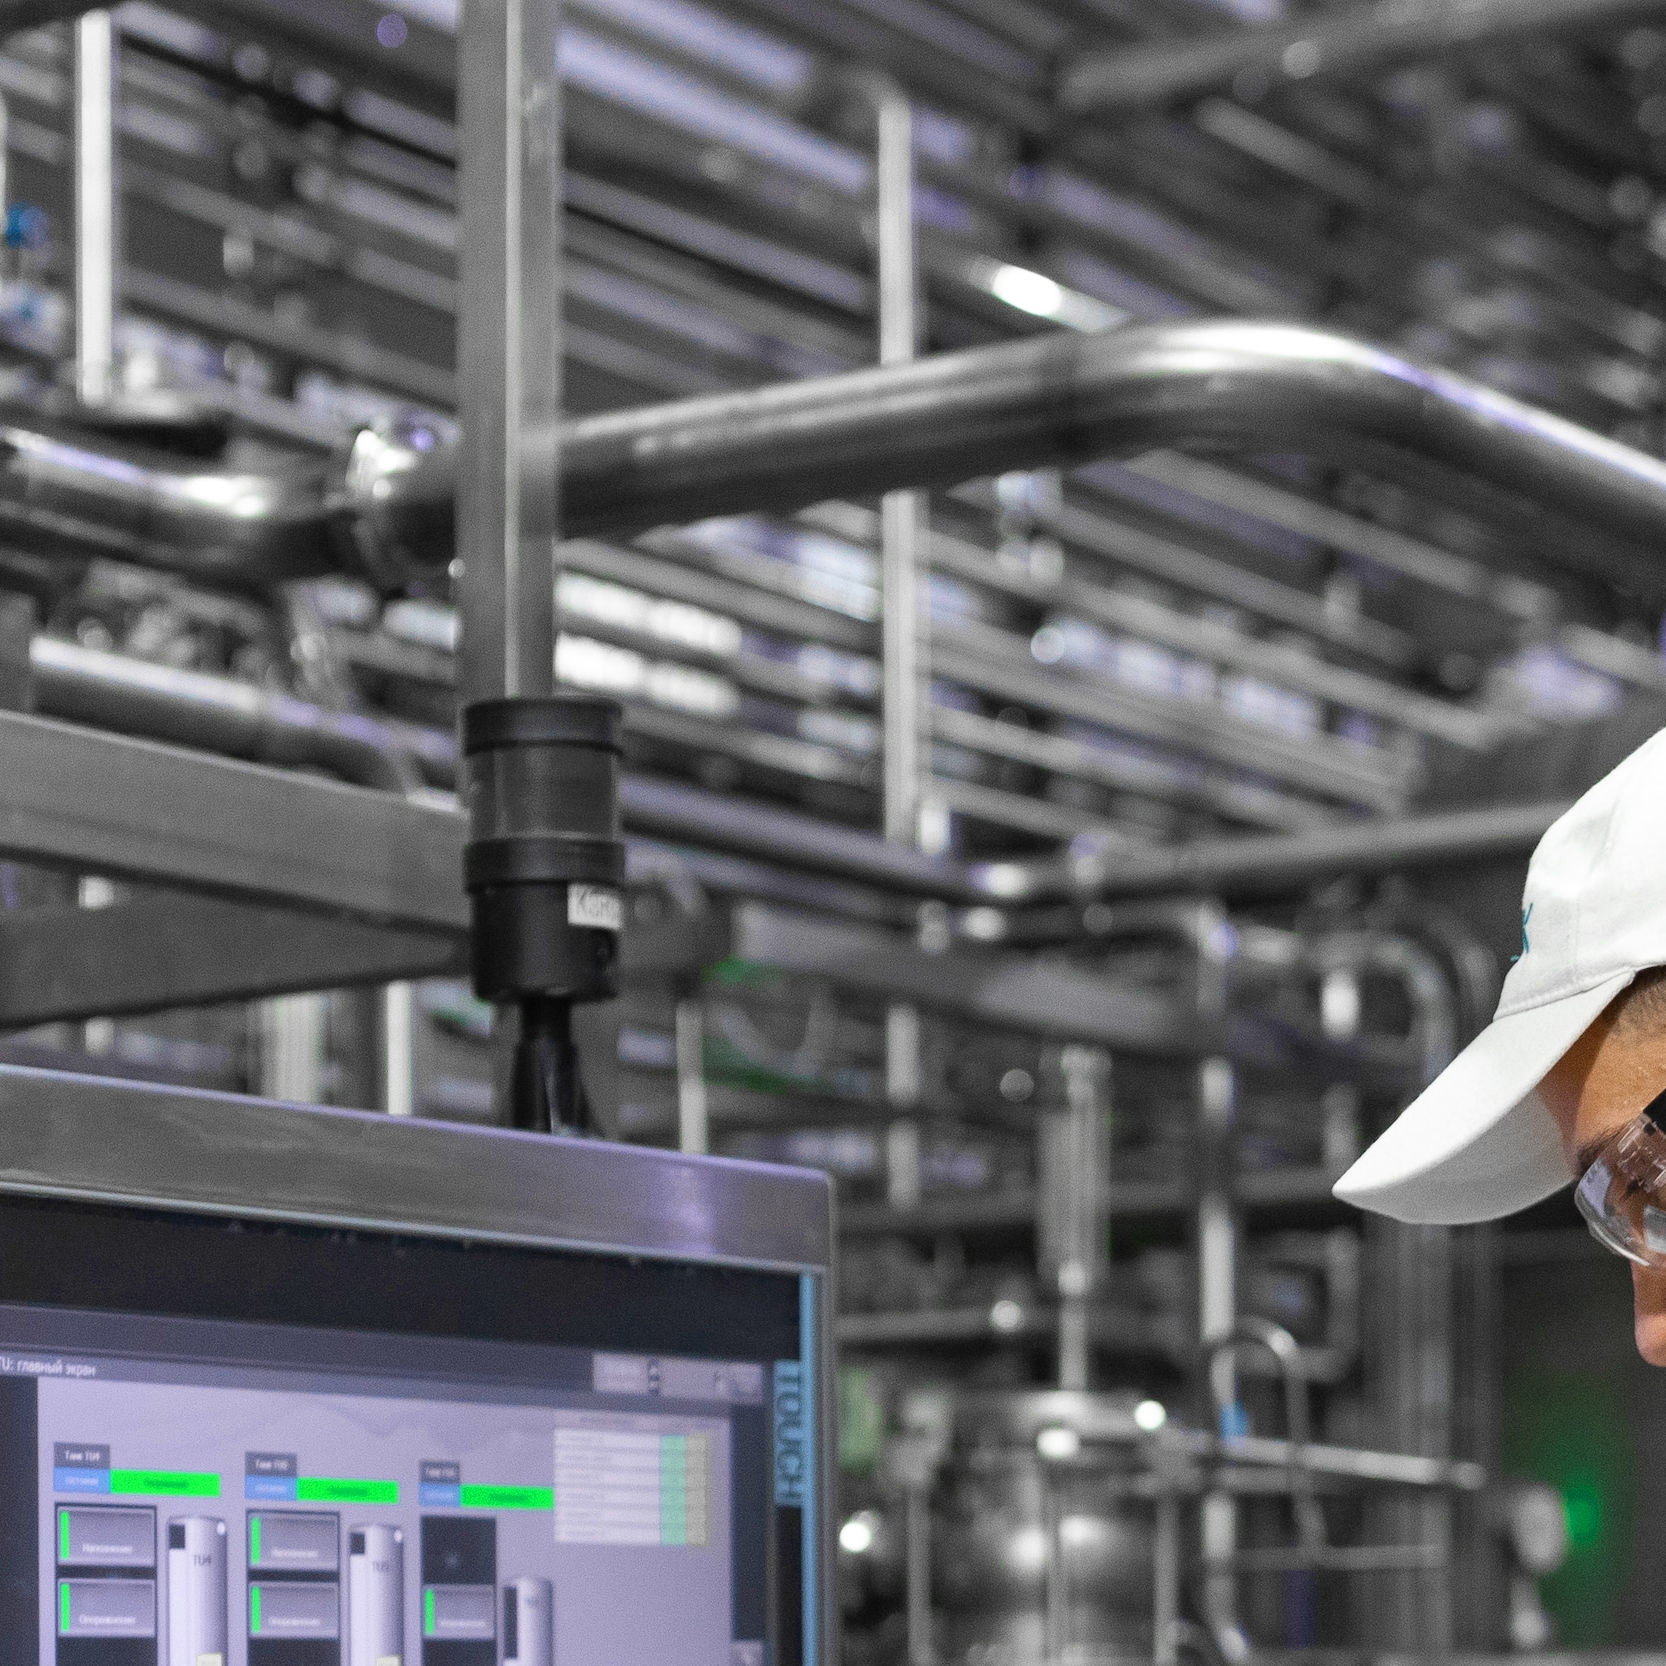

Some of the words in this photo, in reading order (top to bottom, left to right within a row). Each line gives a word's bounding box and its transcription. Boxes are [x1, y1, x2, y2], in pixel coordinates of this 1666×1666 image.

[17, 1359, 63, 1375] главный
[65, 1363, 96, 1377] экран
[777, 1372, 803, 1503] TOUCH
